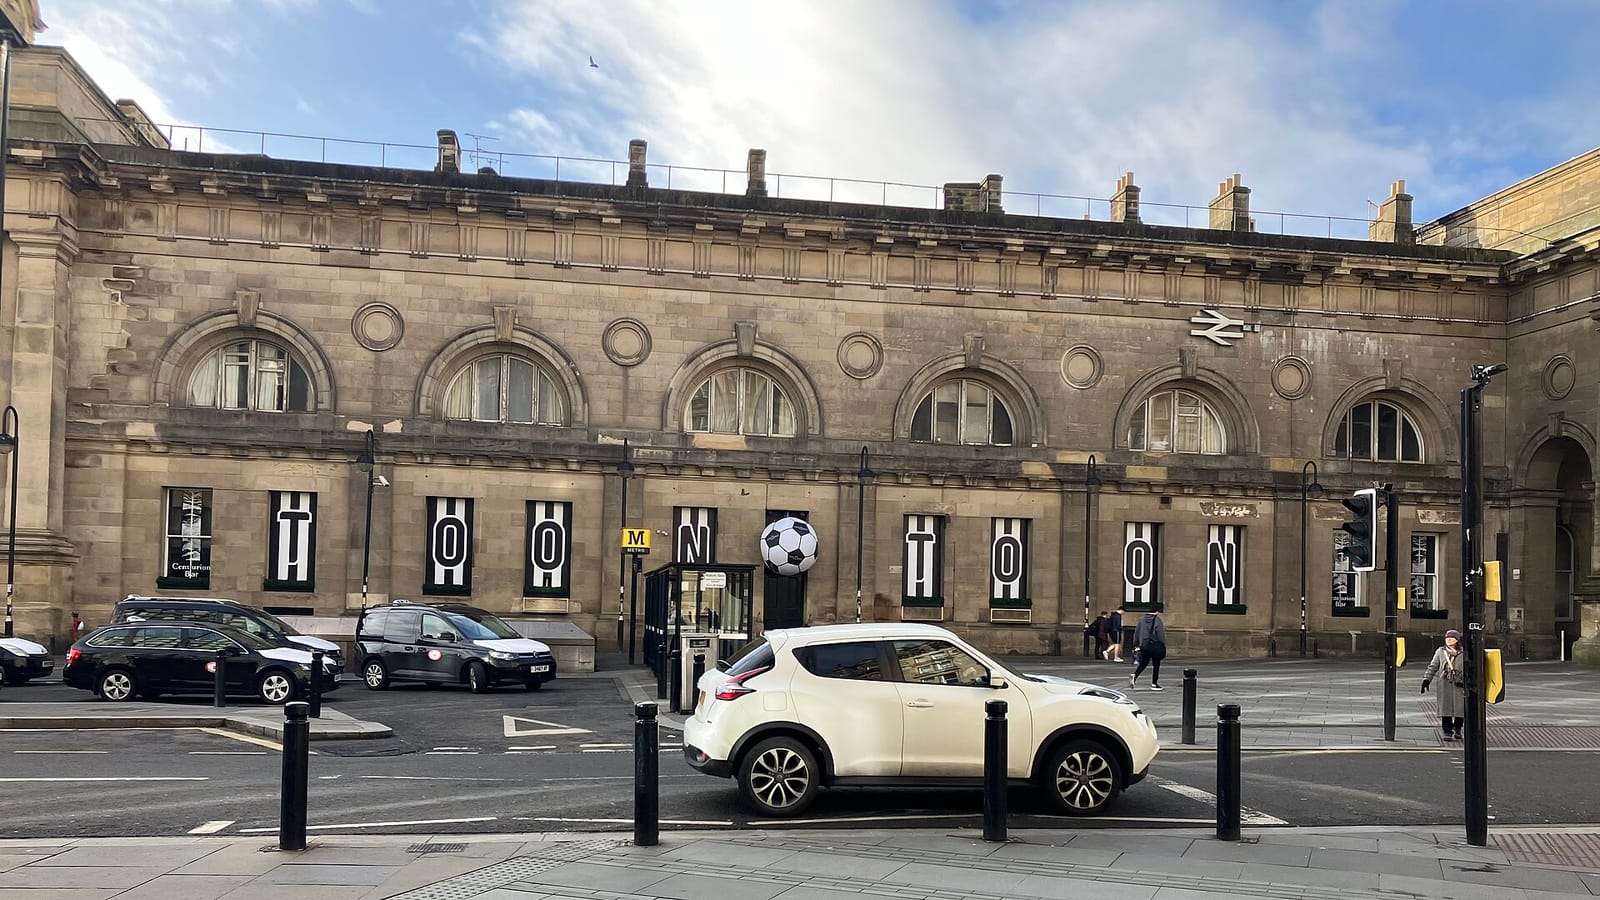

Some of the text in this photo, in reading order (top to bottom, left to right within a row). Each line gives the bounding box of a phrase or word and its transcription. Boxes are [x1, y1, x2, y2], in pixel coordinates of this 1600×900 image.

[277, 509, 710, 573] T O O N
[628, 530, 645, 545] M
[171, 562, 211, 571] Centurion
[906, 531, 1236, 591] T O O N
[184, 570, 199, 578] Bar
